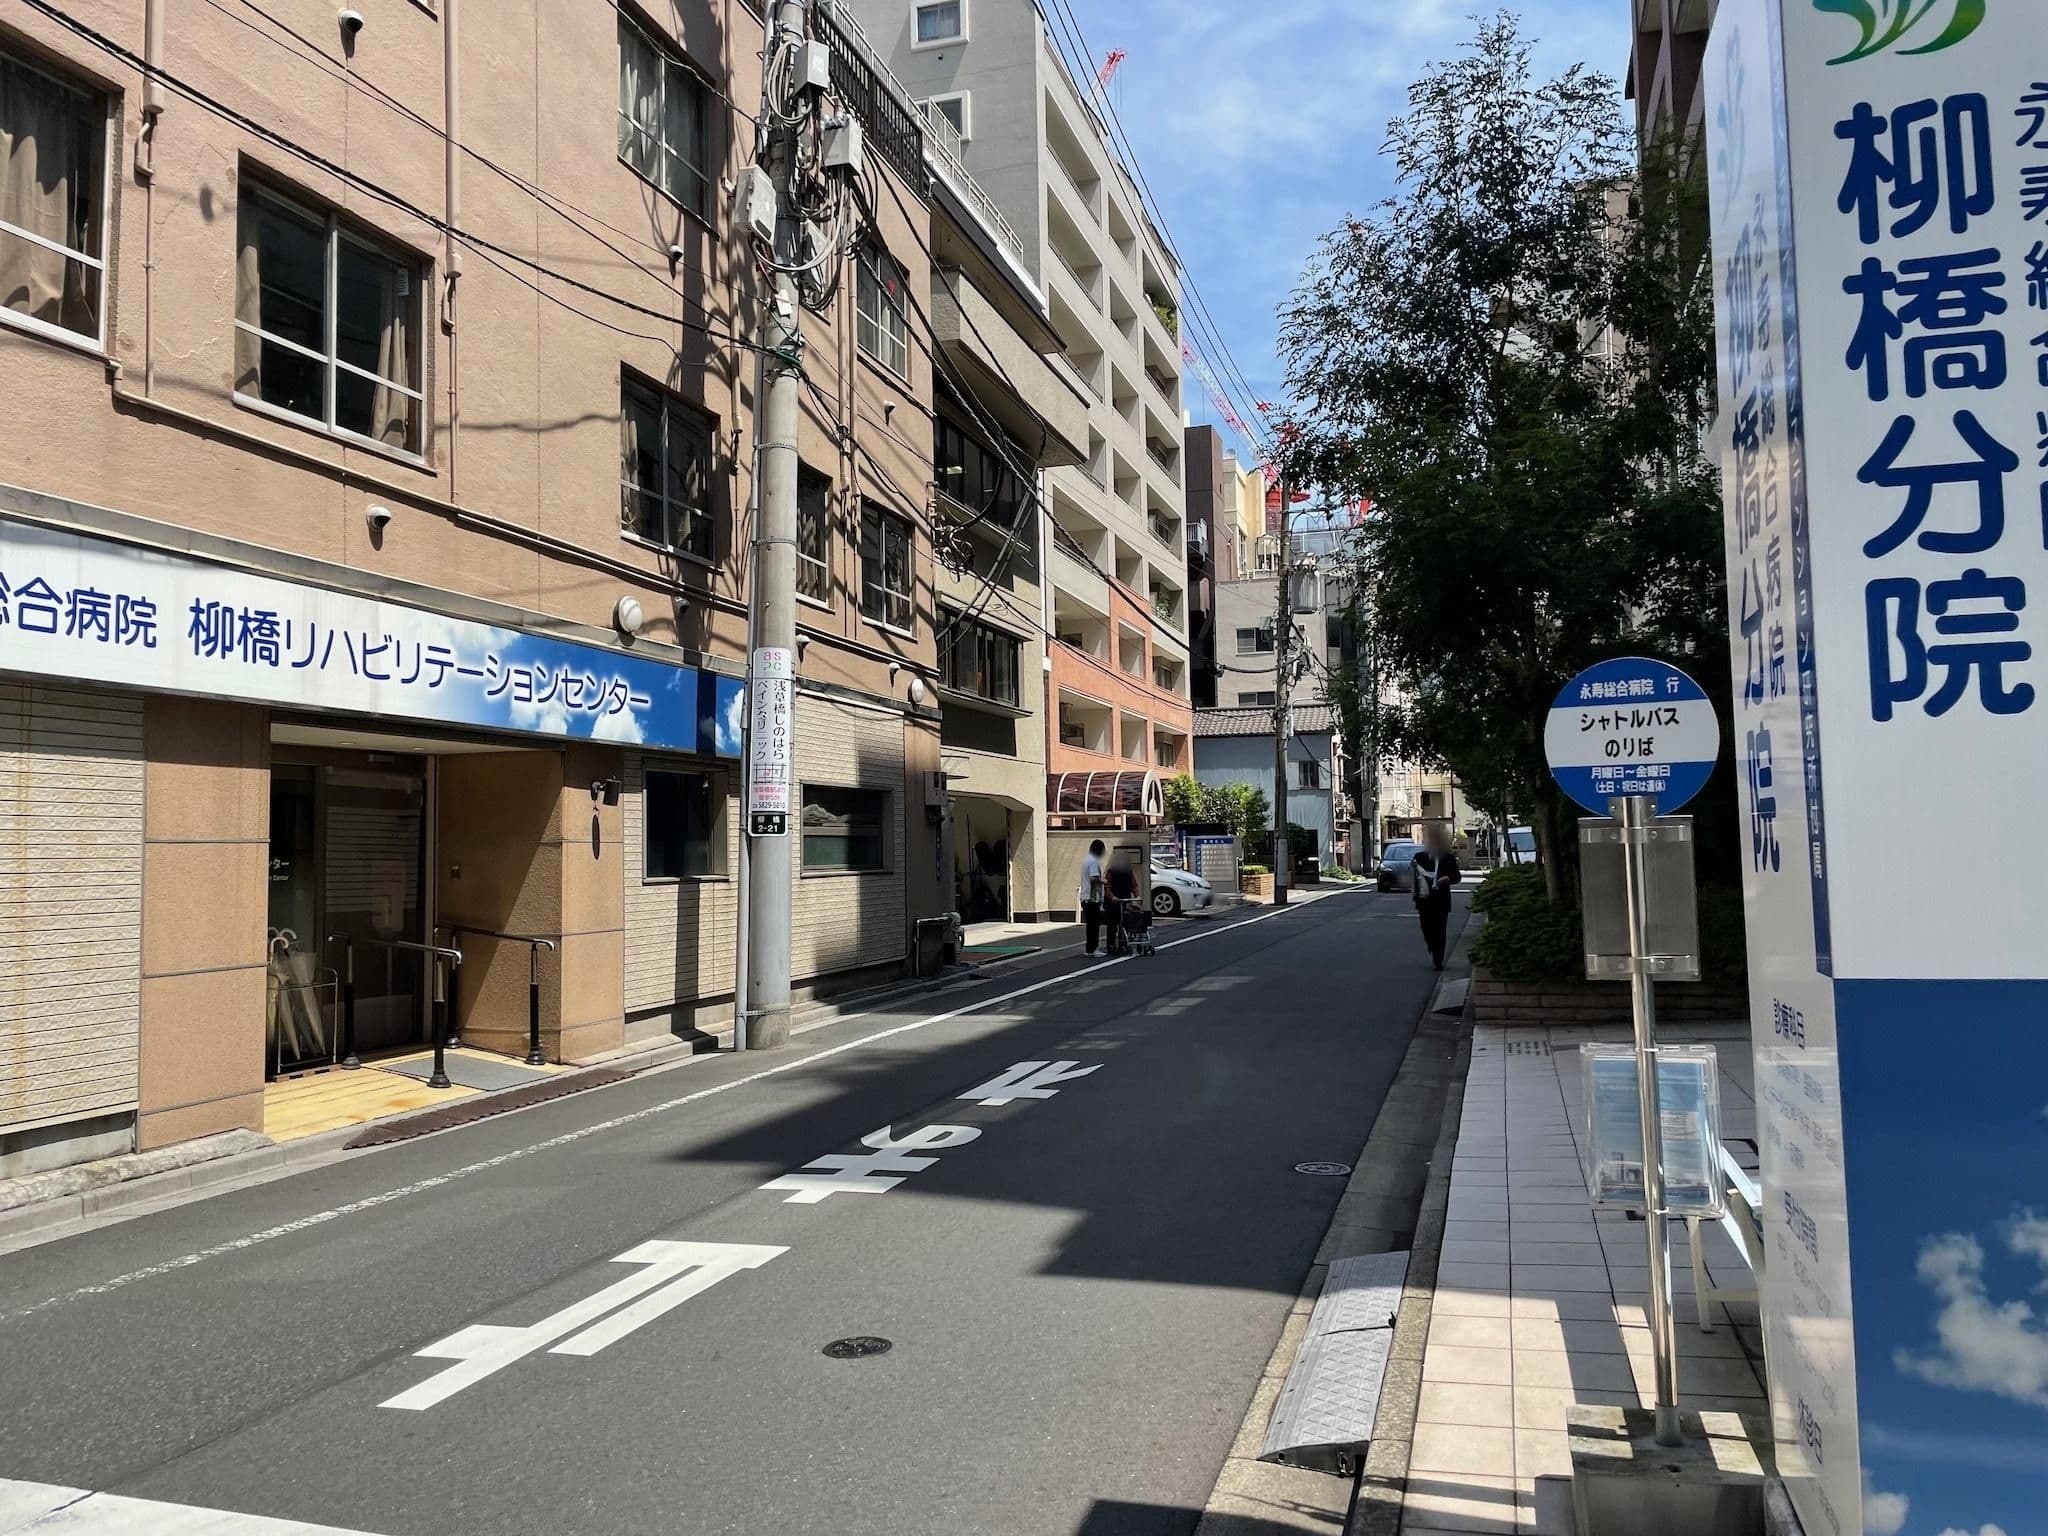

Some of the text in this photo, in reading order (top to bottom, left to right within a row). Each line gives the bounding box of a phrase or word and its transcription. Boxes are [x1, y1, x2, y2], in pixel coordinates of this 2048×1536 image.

[1834, 91, 2035, 722] 柳橋分院
[1753, 193, 1786, 701] 永寿総合病院
[1725, 222, 1780, 872] 柳橋分院
[0, 572, 651, 715] 合病院 柳橋リハビリテーションセンター
[756, 680, 769, 760] ペインクリニック
[773, 680, 786, 760] 浅草橋しのはら
[1579, 676, 1681, 700] 永寿総合病院 行
[1580, 707, 1681, 732] シャトルバス
[1604, 736, 1655, 758] のりば
